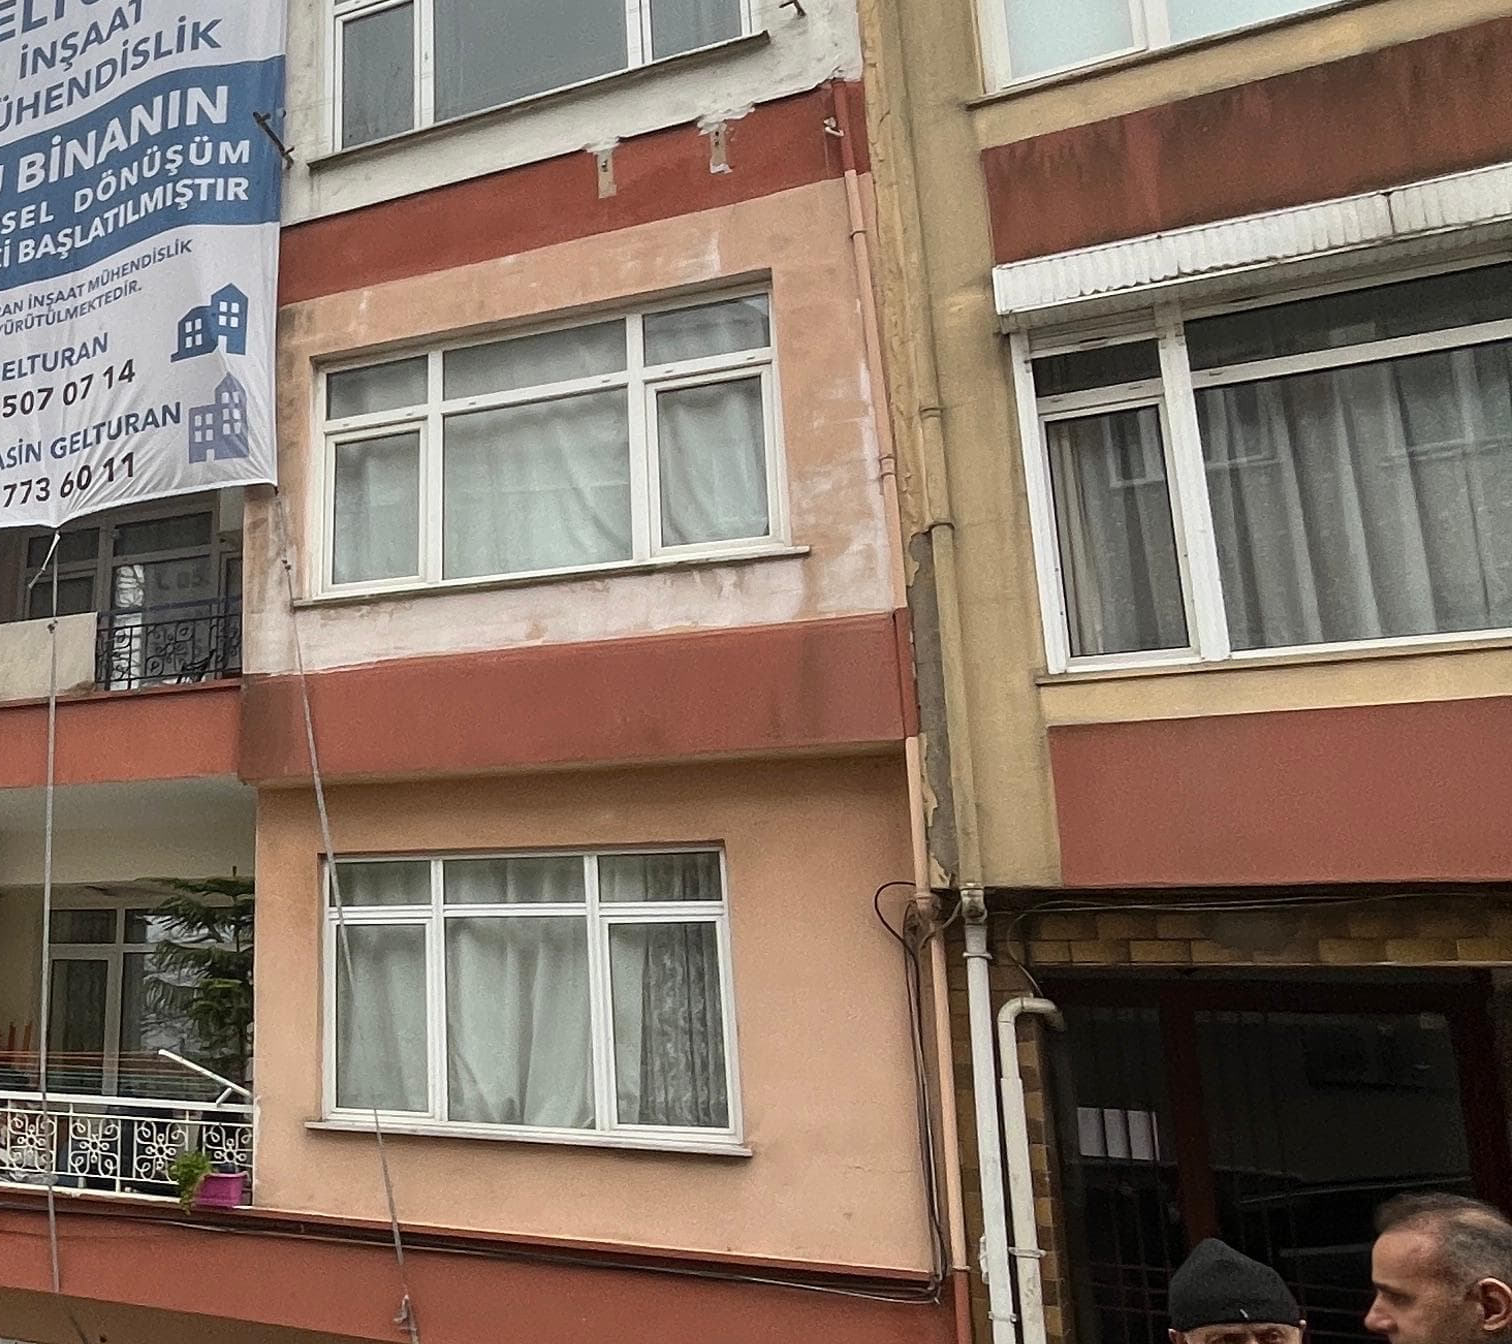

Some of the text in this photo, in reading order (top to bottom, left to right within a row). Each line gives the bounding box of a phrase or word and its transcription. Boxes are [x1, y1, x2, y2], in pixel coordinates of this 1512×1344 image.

[17, 85, 229, 194] BİNANIN
[74, 136, 250, 214] DÖNÜŞÜM
[18, 177, 249, 261] BAŞLATILMIŞTIR
[28, 284, 85, 311] İNŞAAT
[88, 239, 193, 292] MÜHENDİSLİK
[2, 387, 54, 418] 507
[62, 374, 94, 406] 07
[103, 359, 136, 389] 14
[50, 402, 181, 459] GELTURAN
[3, 478, 50, 508] 773
[60, 465, 92, 498] 60
[103, 452, 135, 482] 11
